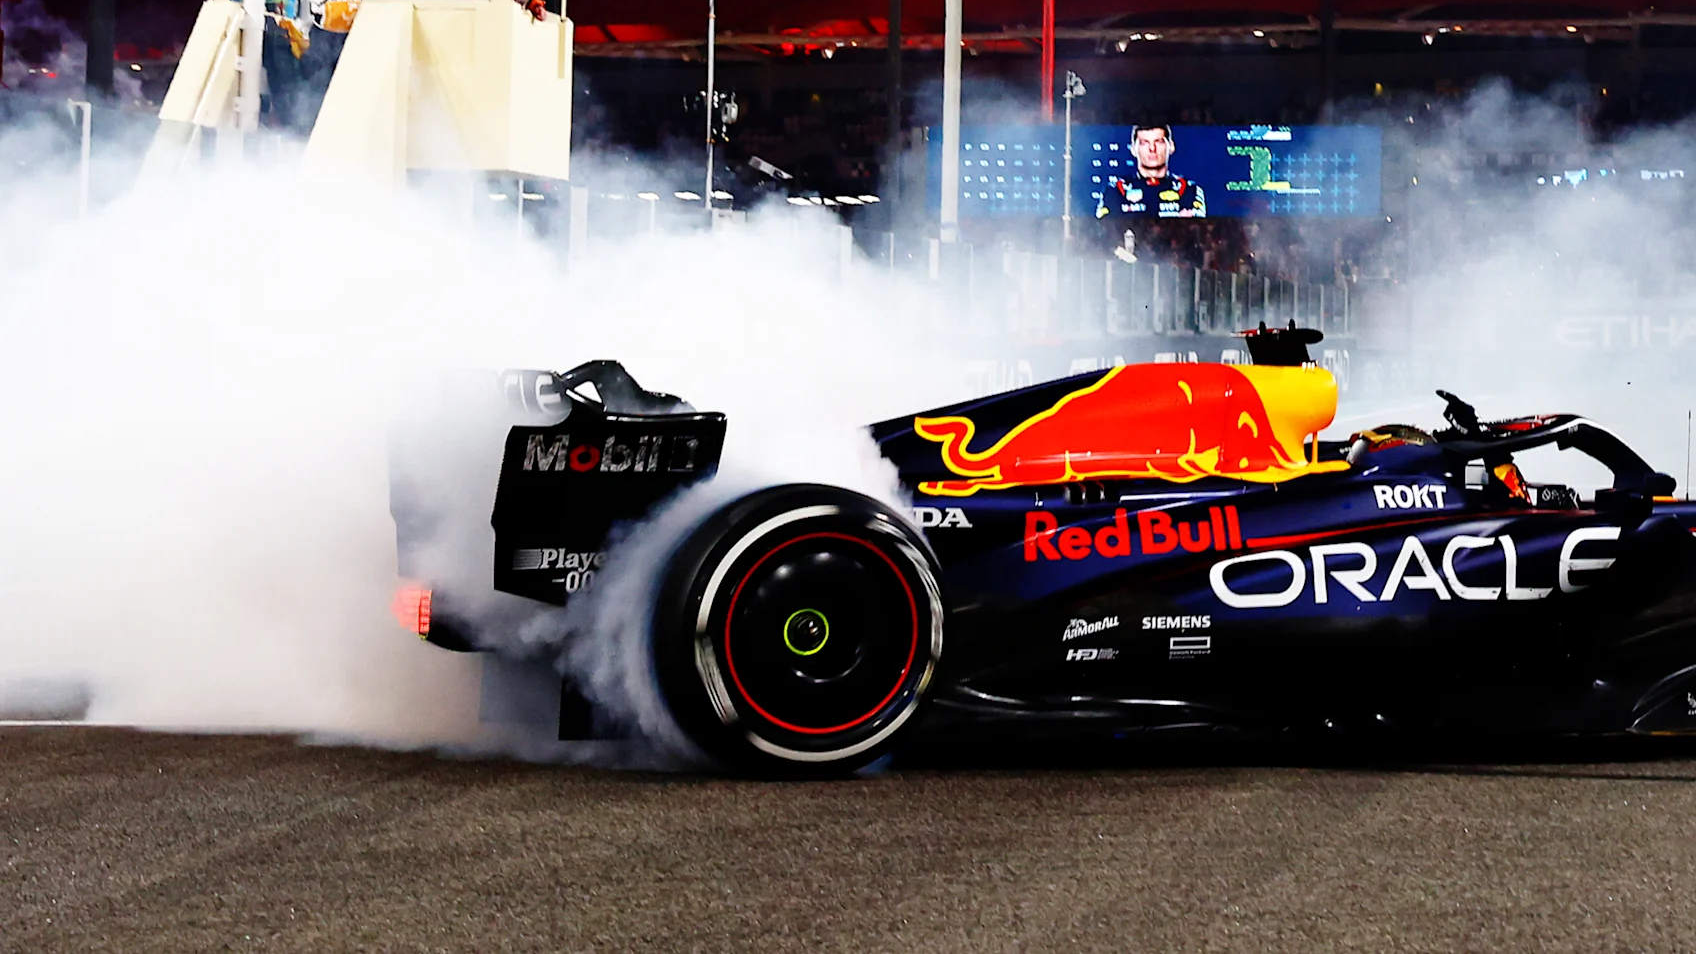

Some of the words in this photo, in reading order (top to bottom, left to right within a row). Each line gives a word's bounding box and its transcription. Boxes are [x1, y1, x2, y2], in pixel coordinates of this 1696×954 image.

[522, 434, 663, 473] Mobil
[1373, 484, 1447, 509] ROKT
[1024, 507, 1132, 562] Red
[1137, 505, 1243, 555] Bull
[1209, 526, 1622, 609] ORACLE
[1142, 615, 1211, 629] SIEMENS
